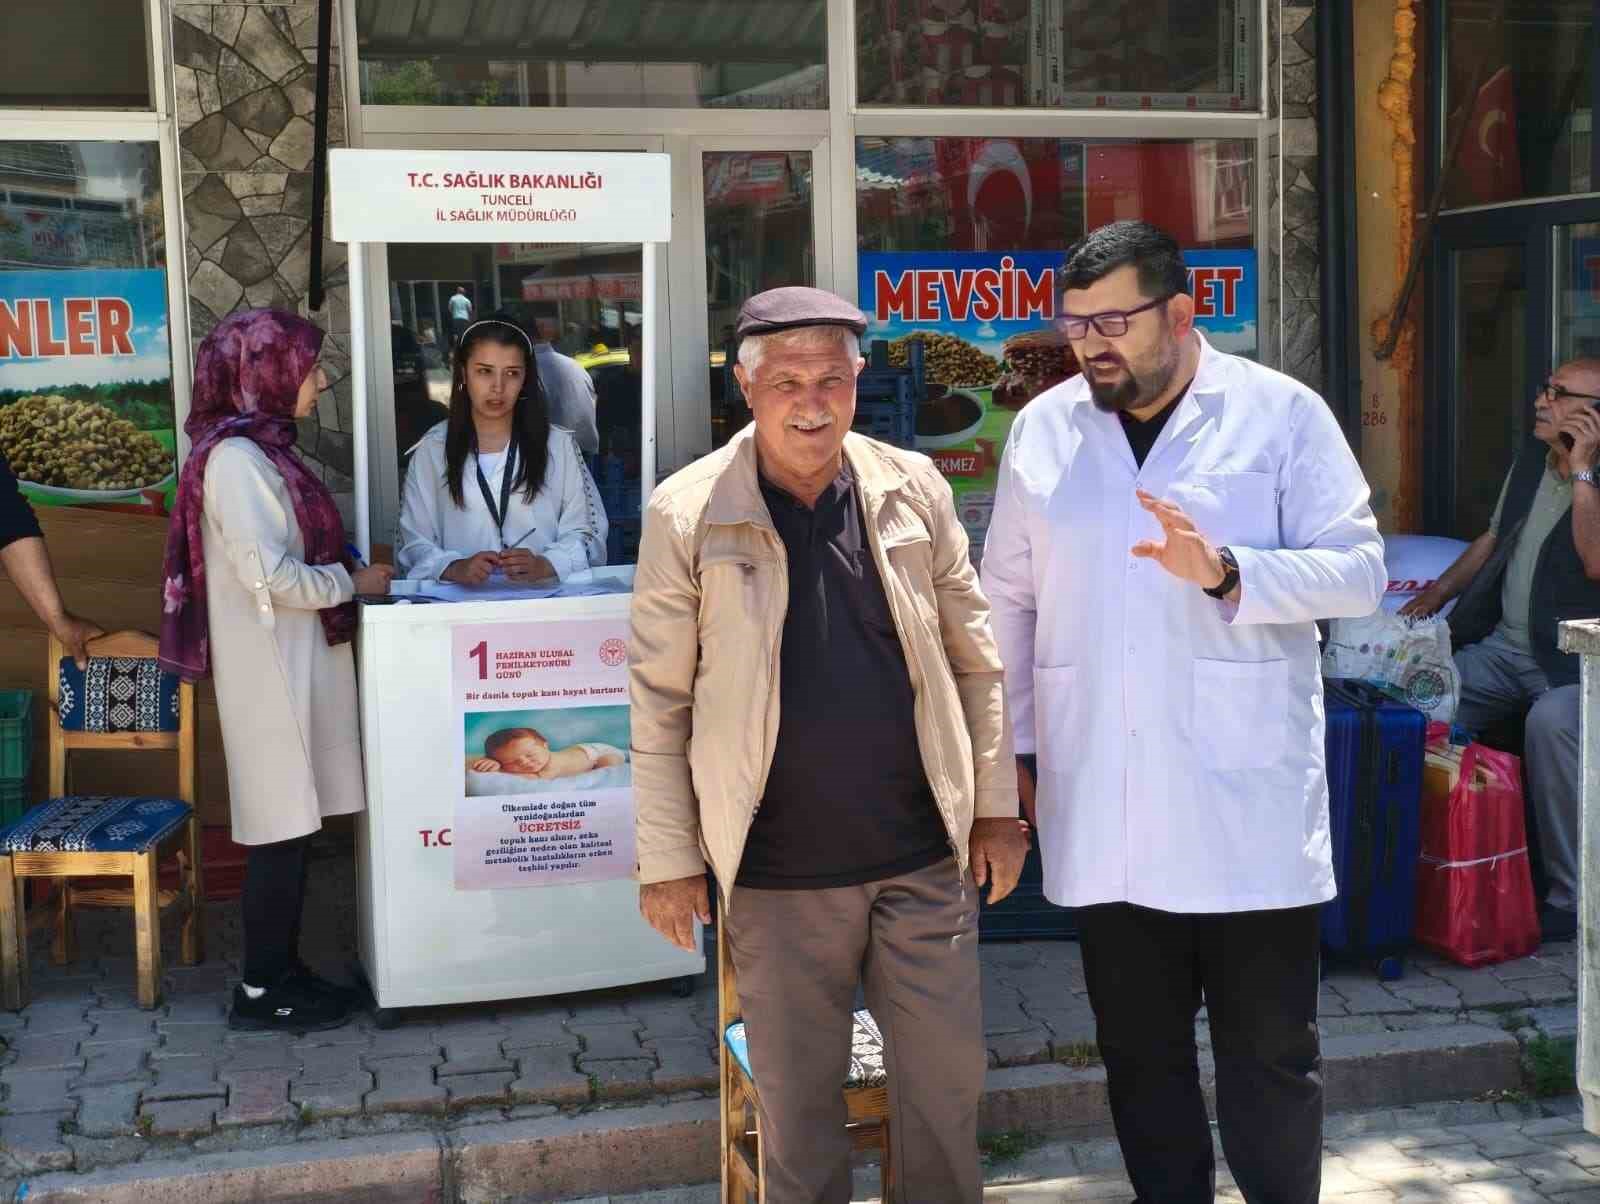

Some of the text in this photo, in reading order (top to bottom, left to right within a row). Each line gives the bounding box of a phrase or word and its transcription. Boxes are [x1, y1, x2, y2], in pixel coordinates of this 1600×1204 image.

[407, 169, 603, 190] T.C. SAĞLIK BAKANLIĞI
[480, 192, 533, 206] TUNCELİ
[436, 208, 577, 223] İL SAĞLIK MÜDÜRLÜĞÜ
[874, 256, 1244, 322] MEVSİM ET
[469, 640, 488, 680] 1
[539, 648, 575, 659] ULUSAL
[482, 689, 509, 700] damla
[512, 690, 538, 700] topuk
[563, 687, 587, 698] hayat
[518, 819, 582, 833] ÜCRETSİZ
[499, 837, 526, 848] topuk
[530, 843, 557, 852] neden
[559, 841, 578, 851] olan
